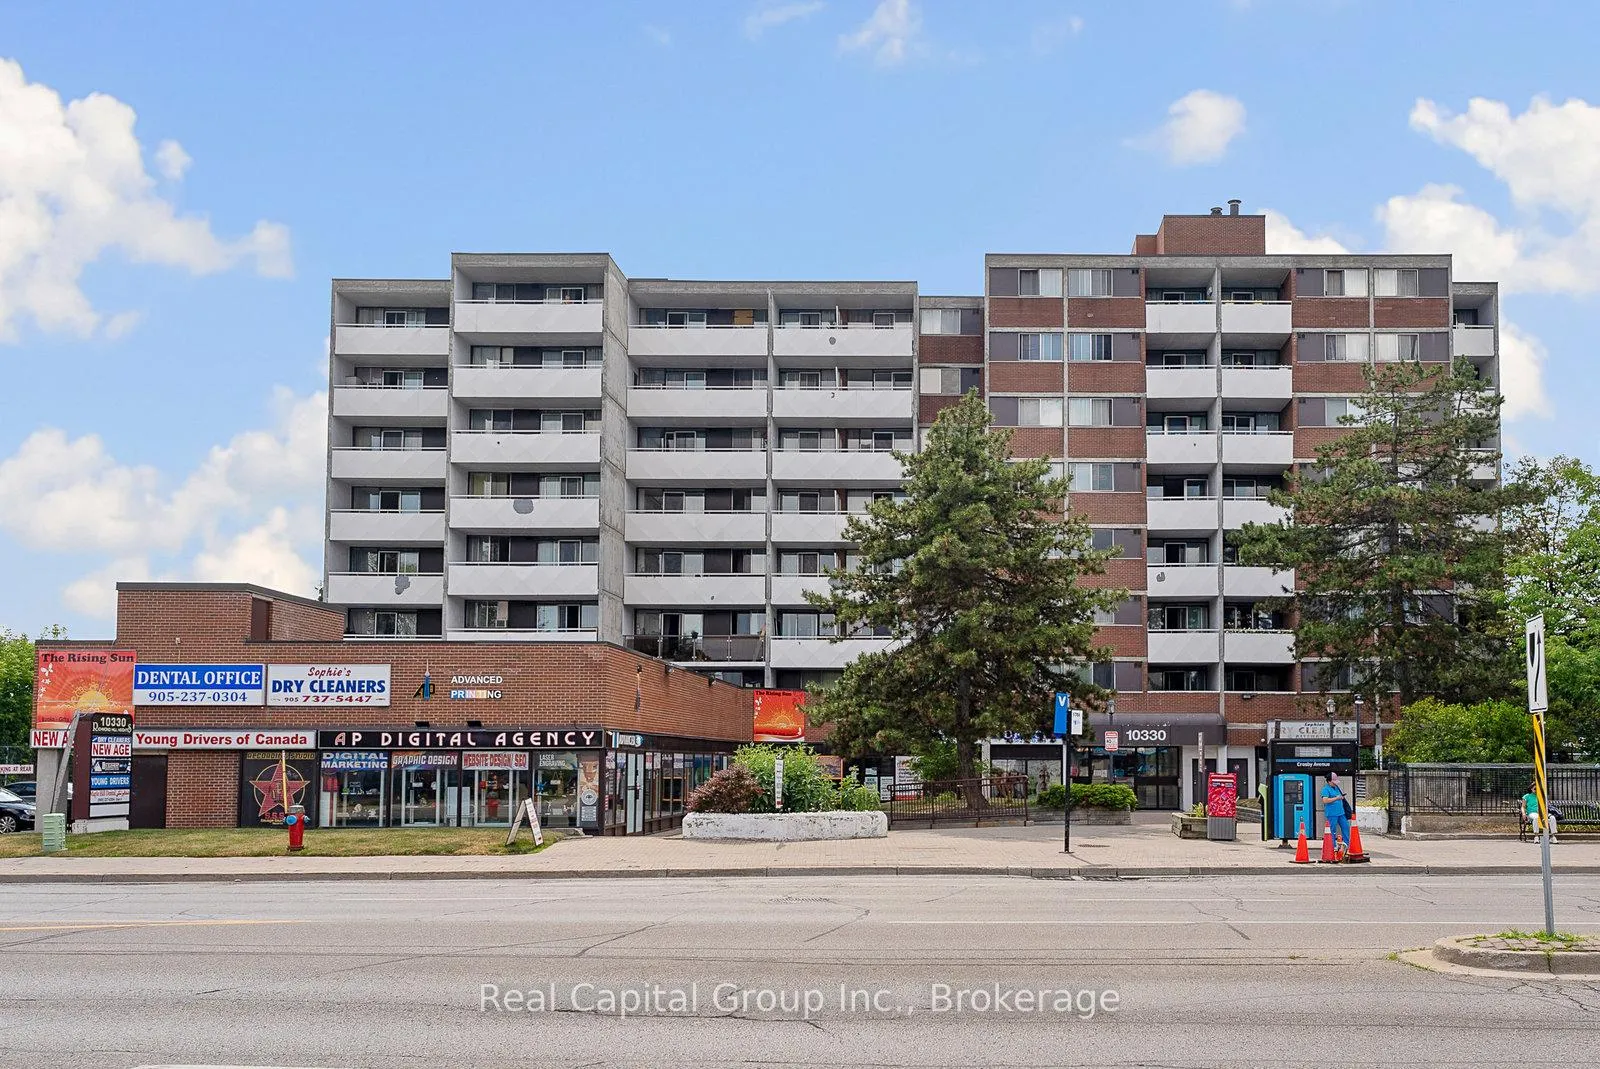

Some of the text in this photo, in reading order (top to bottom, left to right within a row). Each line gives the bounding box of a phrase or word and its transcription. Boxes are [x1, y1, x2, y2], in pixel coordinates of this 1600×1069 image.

[41, 653, 134, 664] The Rising Sun
[137, 671, 261, 685] DENTAL OFFICE
[307, 667, 352, 679] Sophie's
[450, 675, 503, 684] ADVANCED
[272, 680, 386, 693] DRY CLEANERS
[148, 692, 248, 702] 905-237-0304
[302, 695, 372, 703] 737-5447
[450, 690, 502, 699] PRINTING
[100, 717, 127, 727] 10330
[33, 732, 59, 746] NEW
[136, 733, 307, 746] Young Drivers of Canada
[334, 732, 595, 746] AP DIGITAL AGENCY
[1126, 730, 1167, 741] 10330
[93, 744, 129, 755] NEW AGE
[321, 761, 388, 769] MARKETING
[392, 755, 458, 766] GRAPHIC DESIGN
[464, 754, 488, 767] WEBSITE
[91, 777, 130, 786] YOUNG DRIVERS
